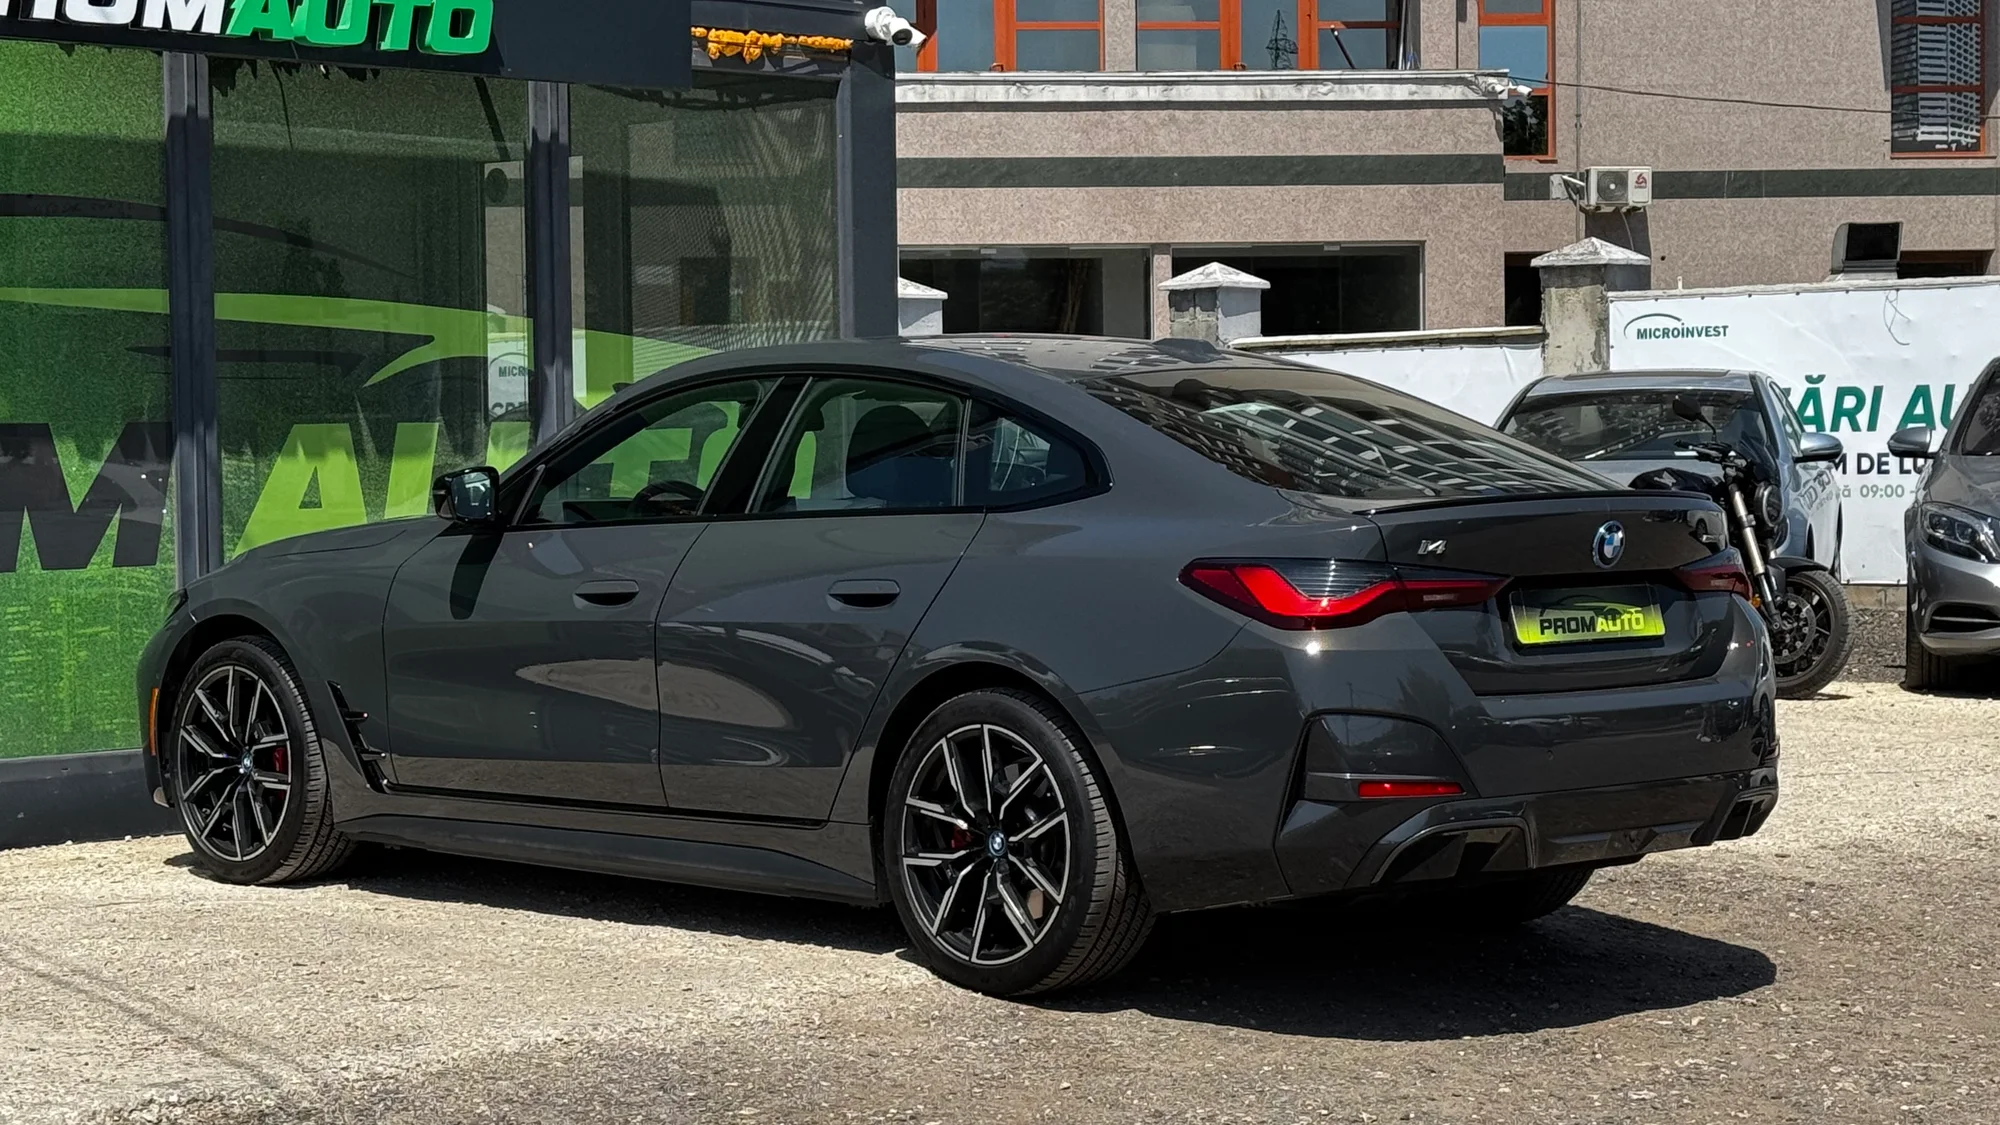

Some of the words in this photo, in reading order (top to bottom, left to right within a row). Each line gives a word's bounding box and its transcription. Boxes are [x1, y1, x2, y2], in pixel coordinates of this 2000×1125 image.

[1857, 453, 1890, 475] DE
[1860, 484, 1905, 499] 09:00
[1539, 612, 1645, 636] PROMAUTO
